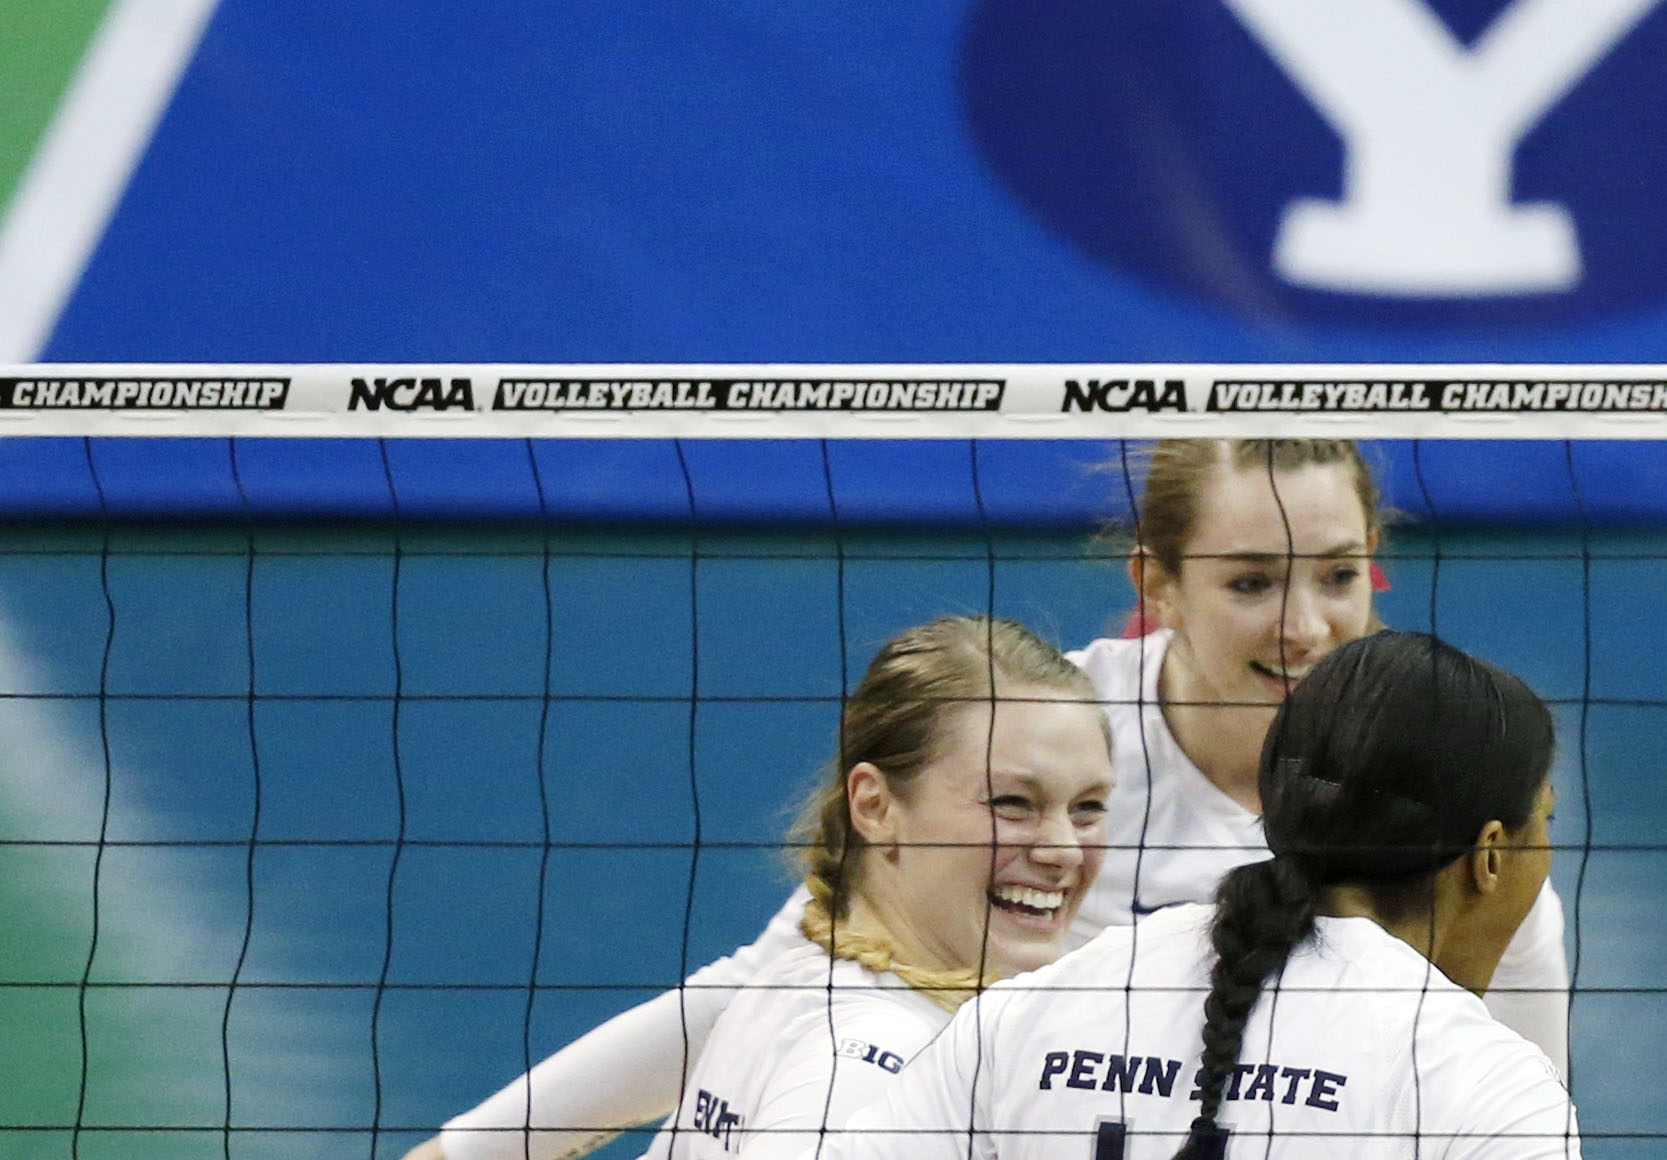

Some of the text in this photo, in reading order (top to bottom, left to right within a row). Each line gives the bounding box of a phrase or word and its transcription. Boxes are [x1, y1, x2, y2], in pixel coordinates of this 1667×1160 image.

[12, 380, 285, 408] CHAMPIONSHIP
[348, 379, 1000, 412] NCAA VOLLEYBALL CHAMPIONSHIP
[1062, 379, 1189, 413] NCAA
[1216, 381, 1431, 411] VOLLEYBALL
[1040, 1050, 1183, 1098] PENN
